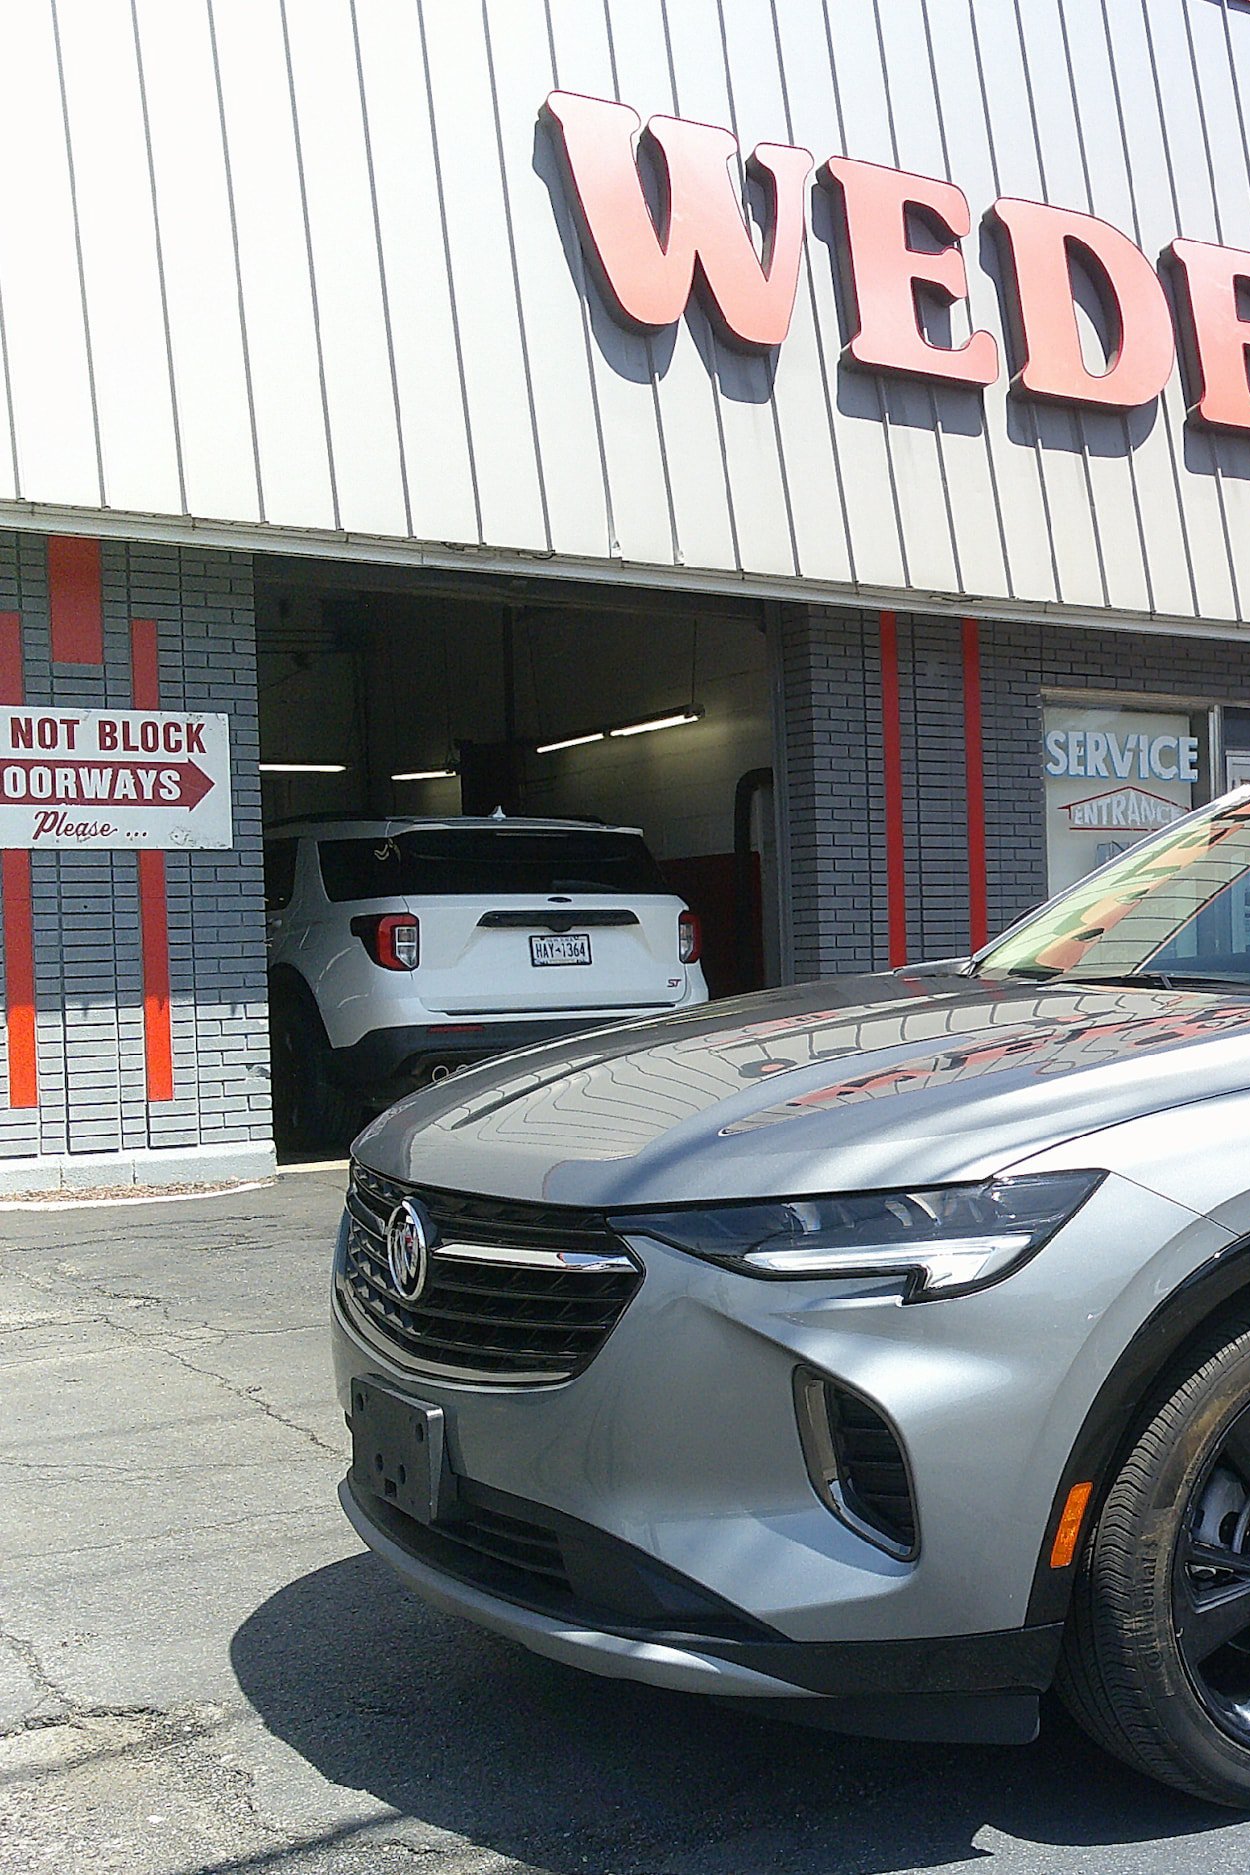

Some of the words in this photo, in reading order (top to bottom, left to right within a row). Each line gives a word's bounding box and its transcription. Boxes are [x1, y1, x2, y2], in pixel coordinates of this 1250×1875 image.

[10, 717, 80, 749] NOT
[98, 720, 207, 753] BLOCK
[1045, 730, 1199, 782] SERVICE
[32, 811, 118, 840] Please
[667, 978, 682, 987] ST
